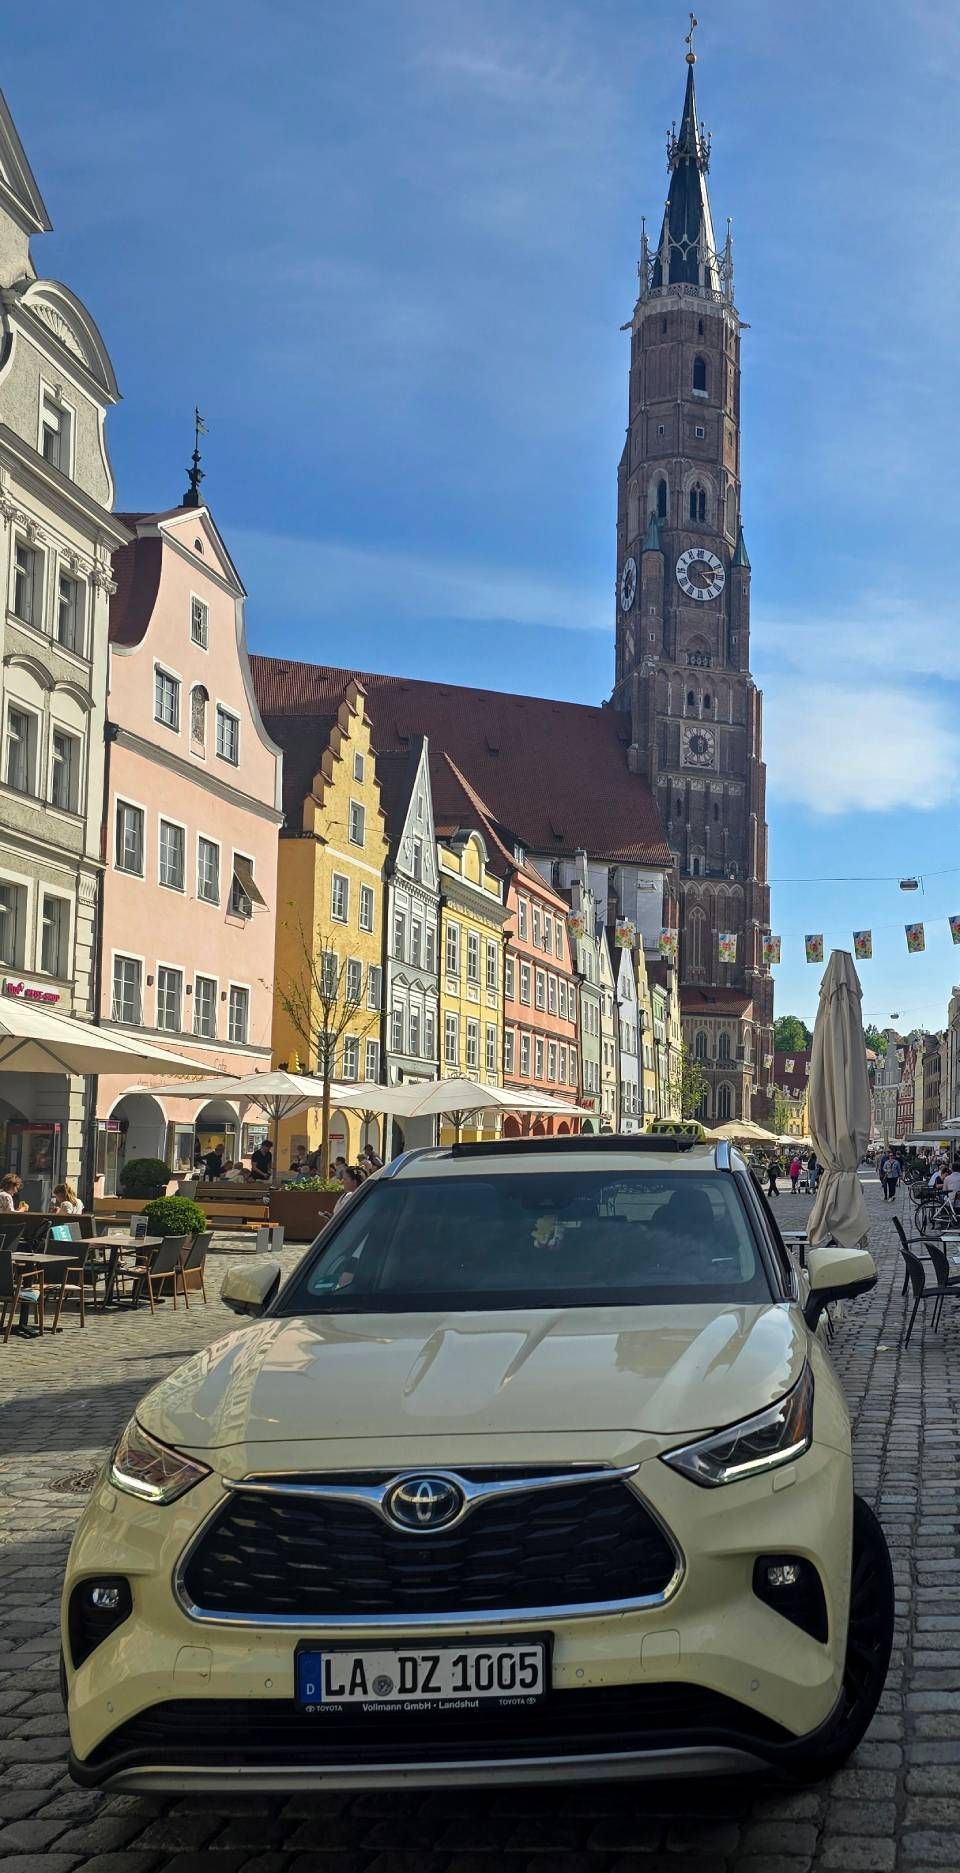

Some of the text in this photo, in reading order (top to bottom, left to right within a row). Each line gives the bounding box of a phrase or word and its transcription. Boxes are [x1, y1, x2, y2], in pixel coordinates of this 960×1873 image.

[655, 1125, 697, 1136] TAXI
[325, 1652, 539, 1697] LA DZ 1005
[306, 1683, 315, 1695] D
[362, 1699, 479, 1712] Vollmann GmbH Landshut
[499, 1697, 526, 1705] TOYOTA
